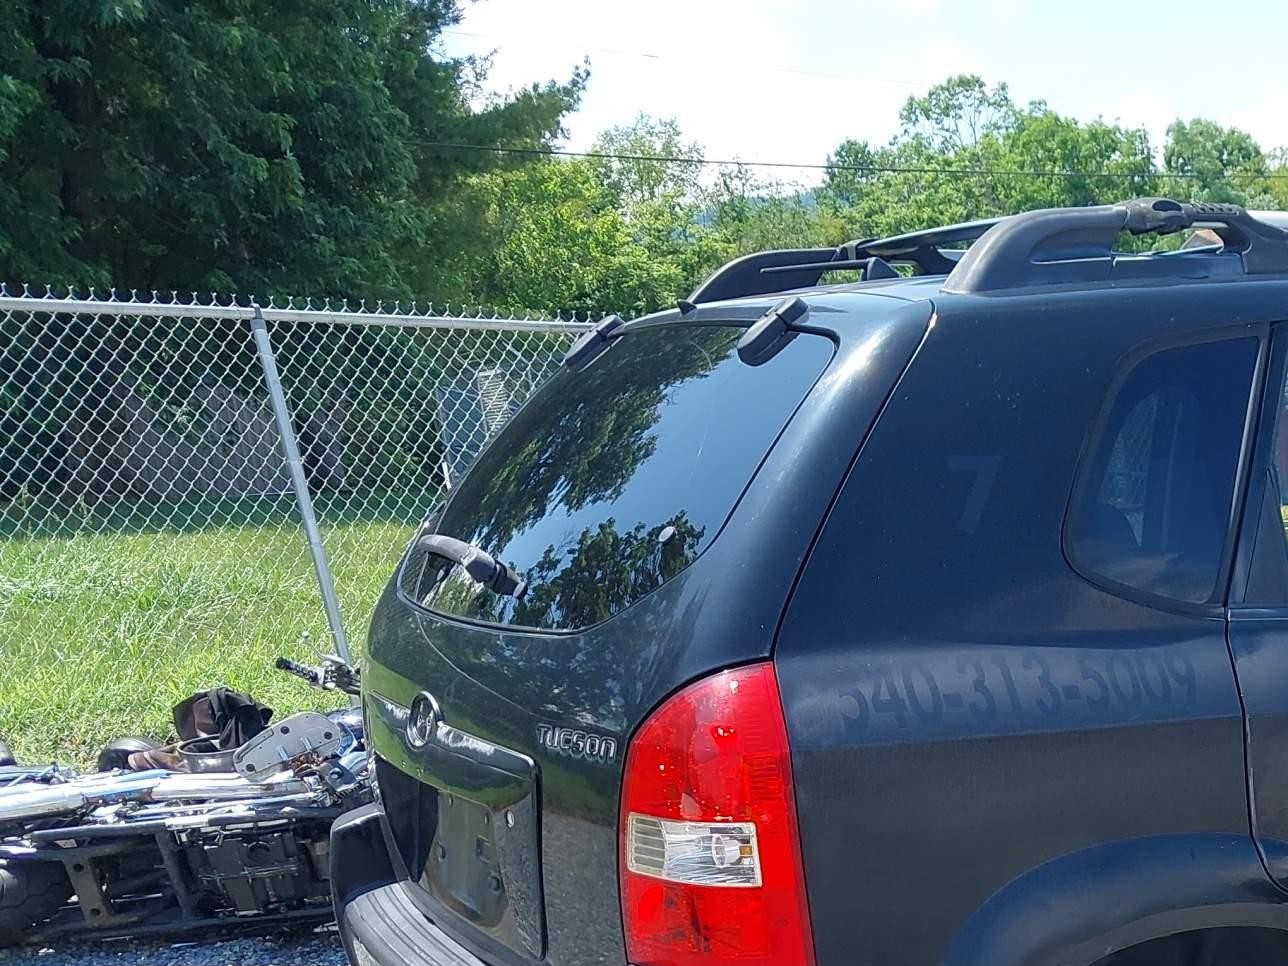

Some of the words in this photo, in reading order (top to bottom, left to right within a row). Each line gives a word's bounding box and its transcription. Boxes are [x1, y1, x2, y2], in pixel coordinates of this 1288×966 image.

[944, 454, 1004, 535] 7
[839, 650, 1197, 737] 540-313-5009
[536, 723, 617, 763] TUCSON
